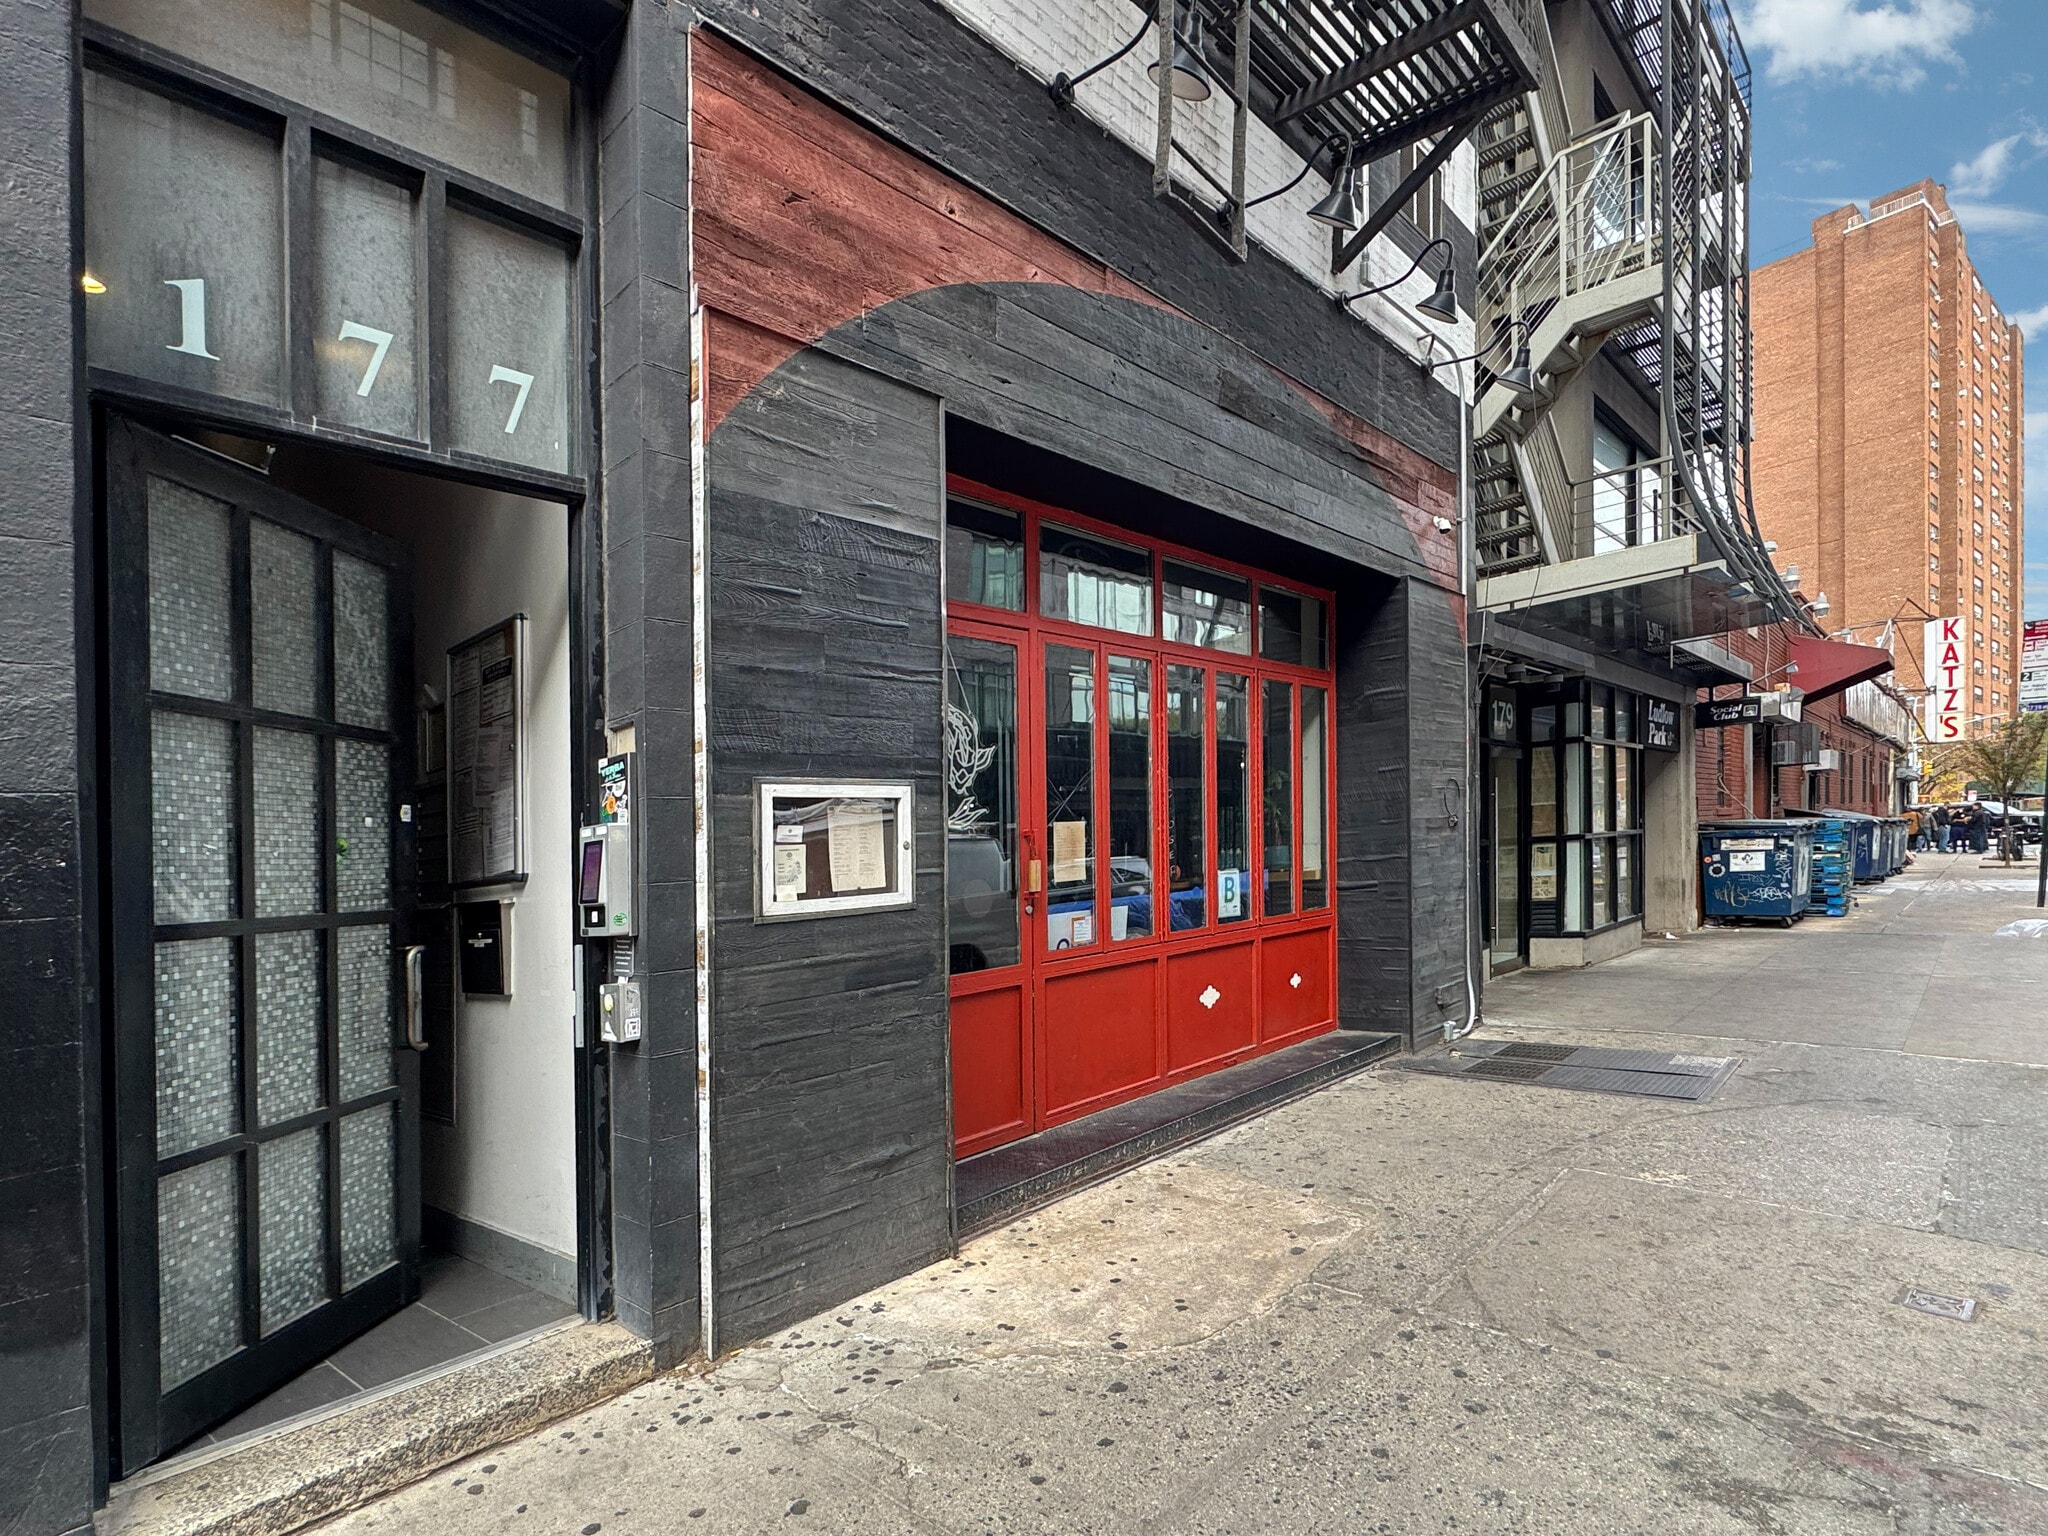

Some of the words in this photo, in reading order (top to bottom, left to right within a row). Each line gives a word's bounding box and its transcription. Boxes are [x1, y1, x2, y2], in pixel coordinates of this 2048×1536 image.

[1941, 618, 1960, 737] KATZ'S
[1492, 700, 1513, 729] 179
[1648, 699, 1674, 725] Ludlow
[1710, 704, 1742, 714] Social
[1713, 712, 1739, 720] Club
[1648, 722, 1666, 746] Park
[1224, 876, 1235, 903] B
